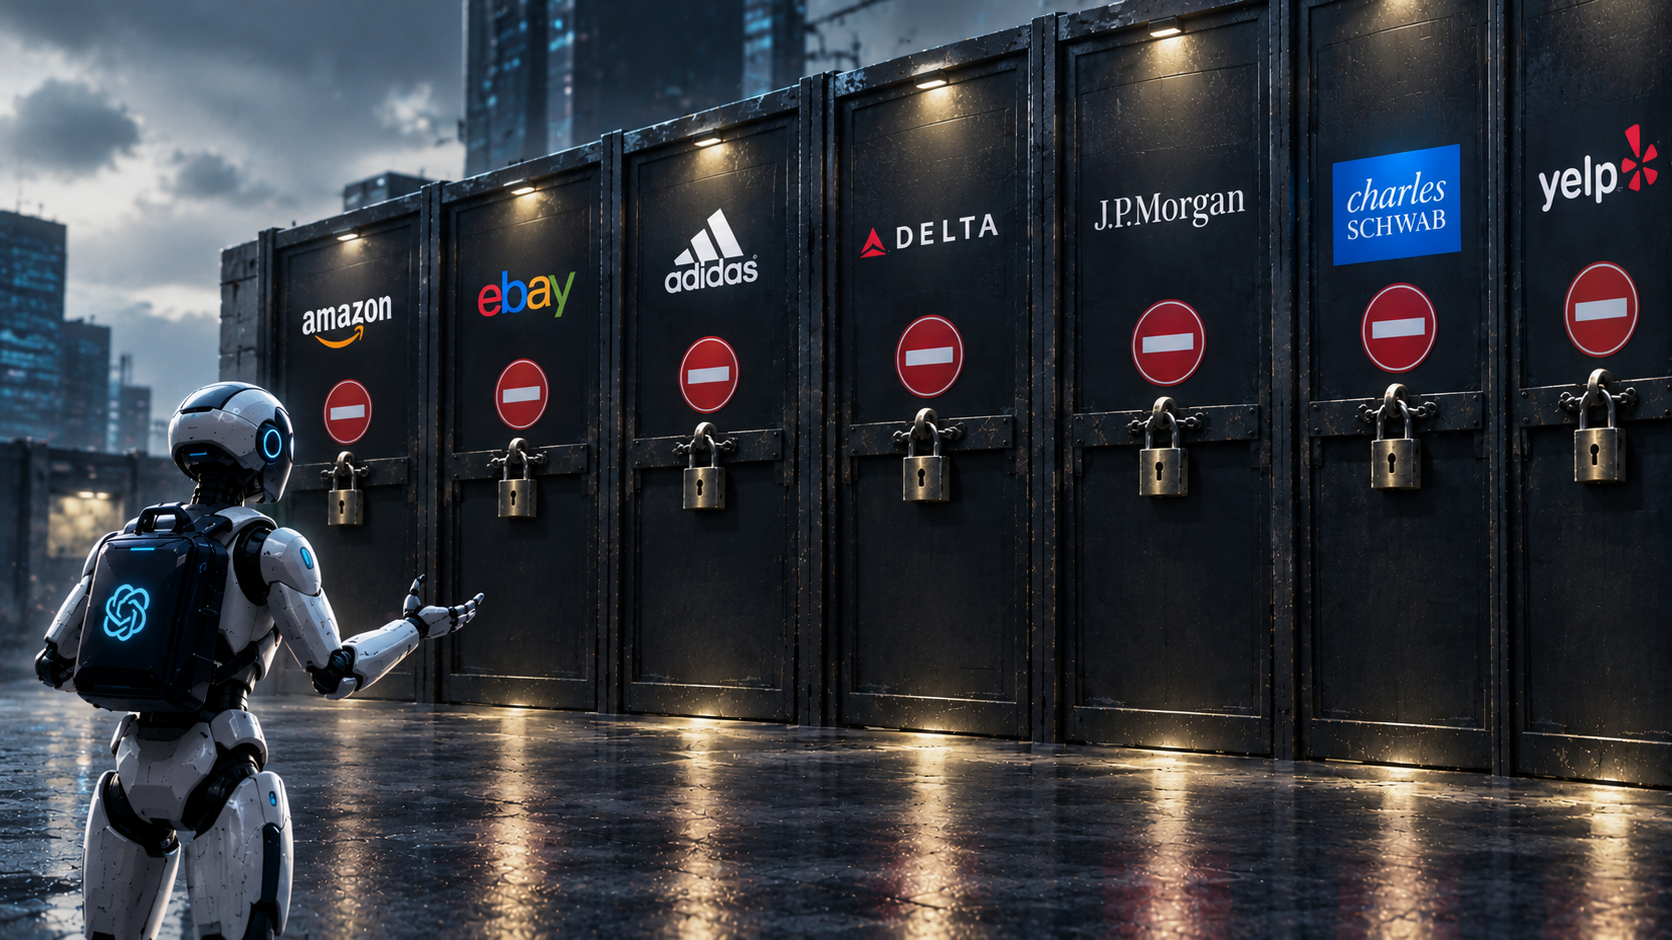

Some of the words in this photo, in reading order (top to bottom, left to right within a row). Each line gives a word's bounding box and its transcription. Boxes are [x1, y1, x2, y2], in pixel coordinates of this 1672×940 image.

[1347, 171, 1447, 213] charles
[1538, 154, 1618, 213] yelp
[1094, 189, 1246, 231] J.P.Morgan
[1347, 209, 1446, 240] SCHWAB
[896, 213, 999, 250] DELTA
[477, 270, 576, 319] ebay
[664, 257, 759, 294] adidas
[302, 295, 393, 336] amazon
